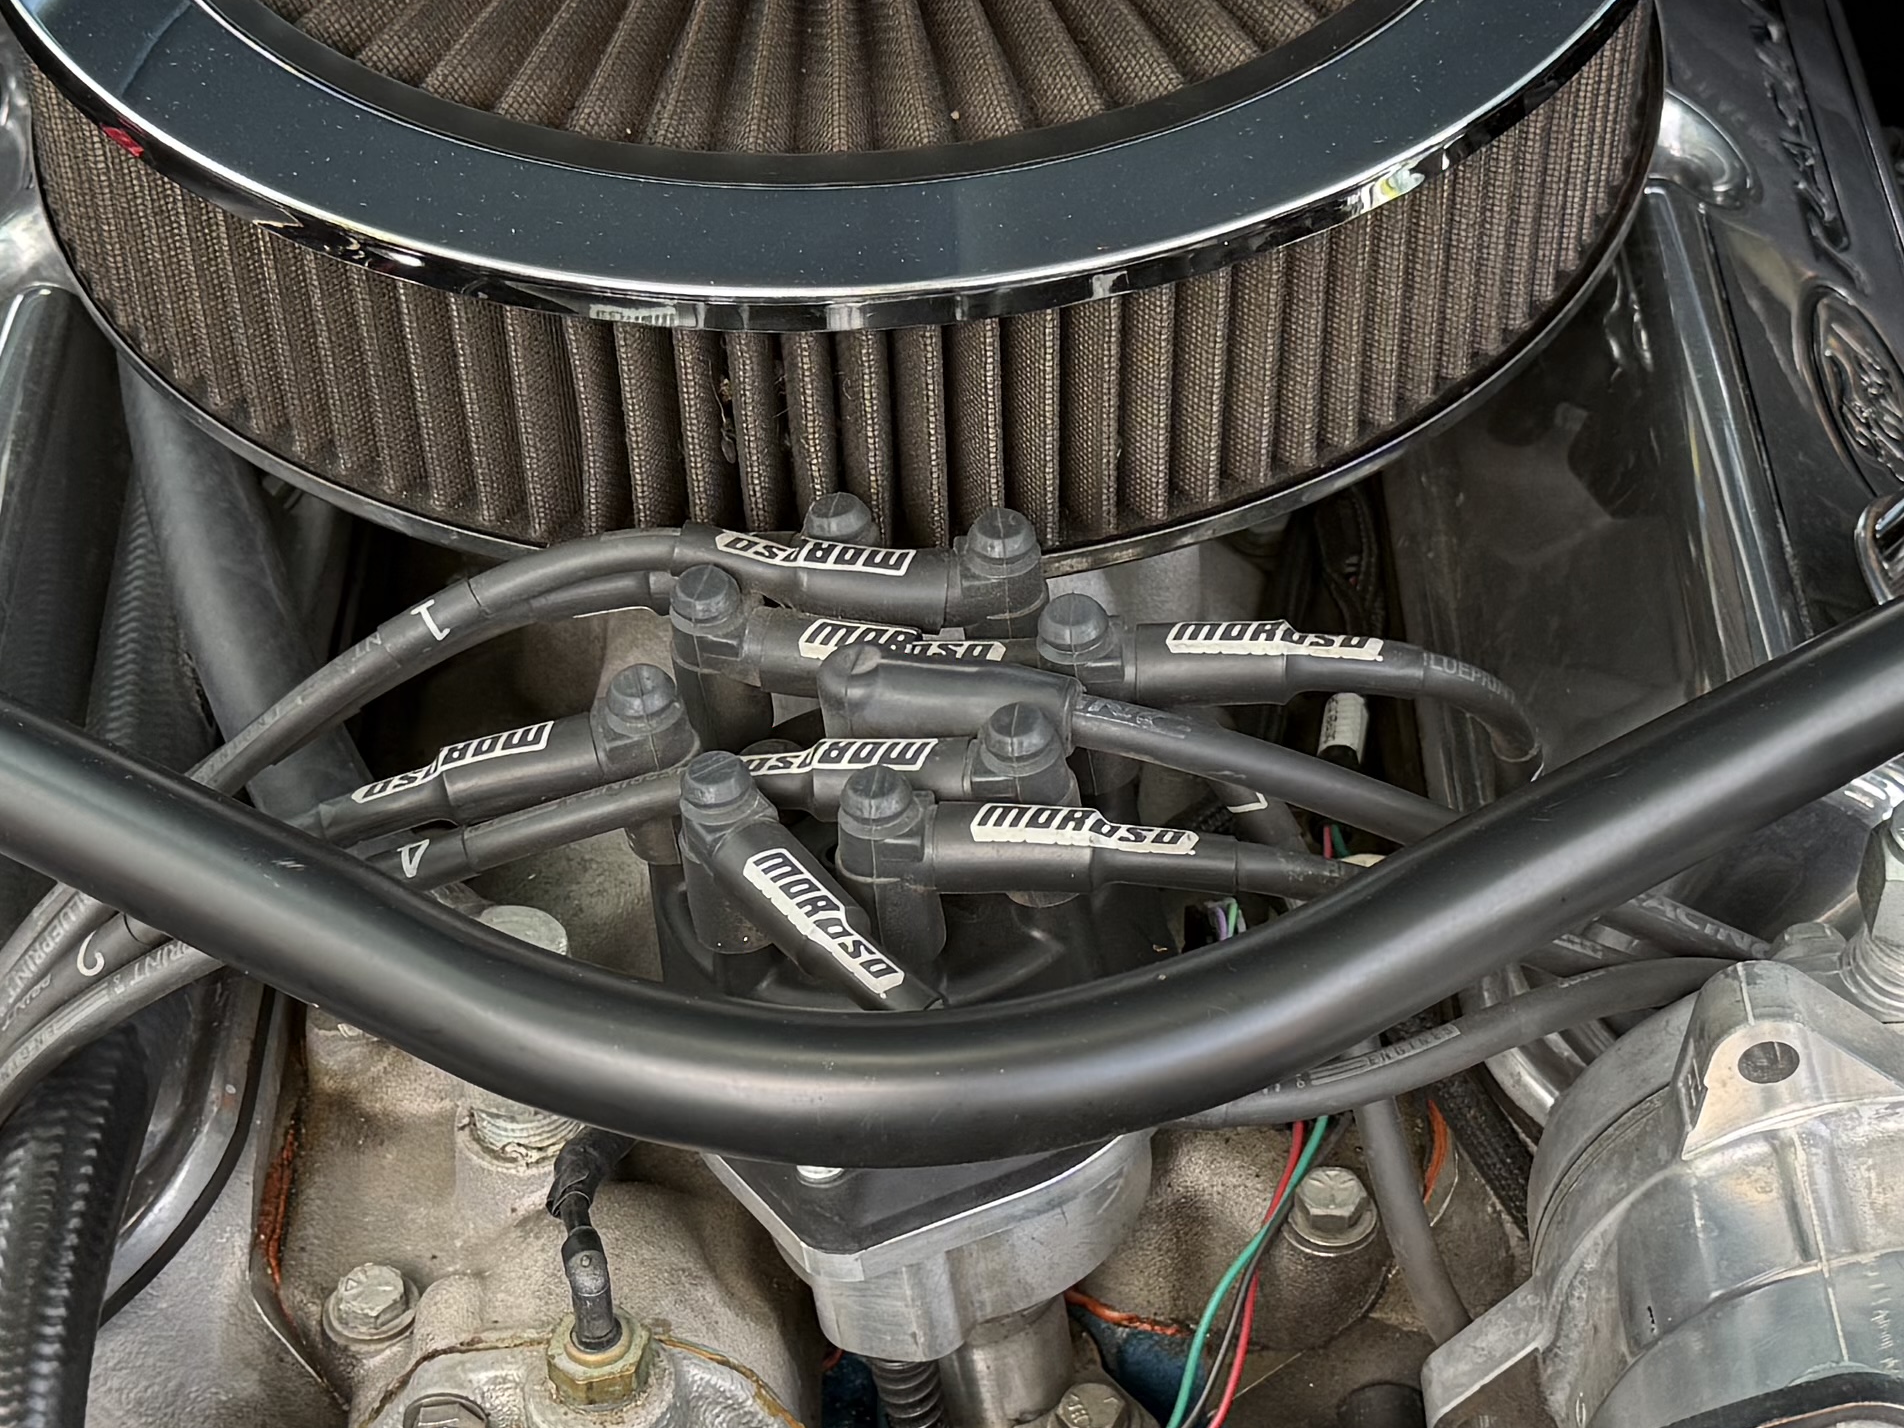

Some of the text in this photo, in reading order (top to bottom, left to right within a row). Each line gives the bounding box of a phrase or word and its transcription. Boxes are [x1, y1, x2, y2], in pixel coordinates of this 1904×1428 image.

[1165, 618, 1386, 662] MOROSO
[350, 720, 555, 804] MOROSO
[969, 801, 1200, 855] MOROSO
[742, 847, 905, 998] MOROSO
